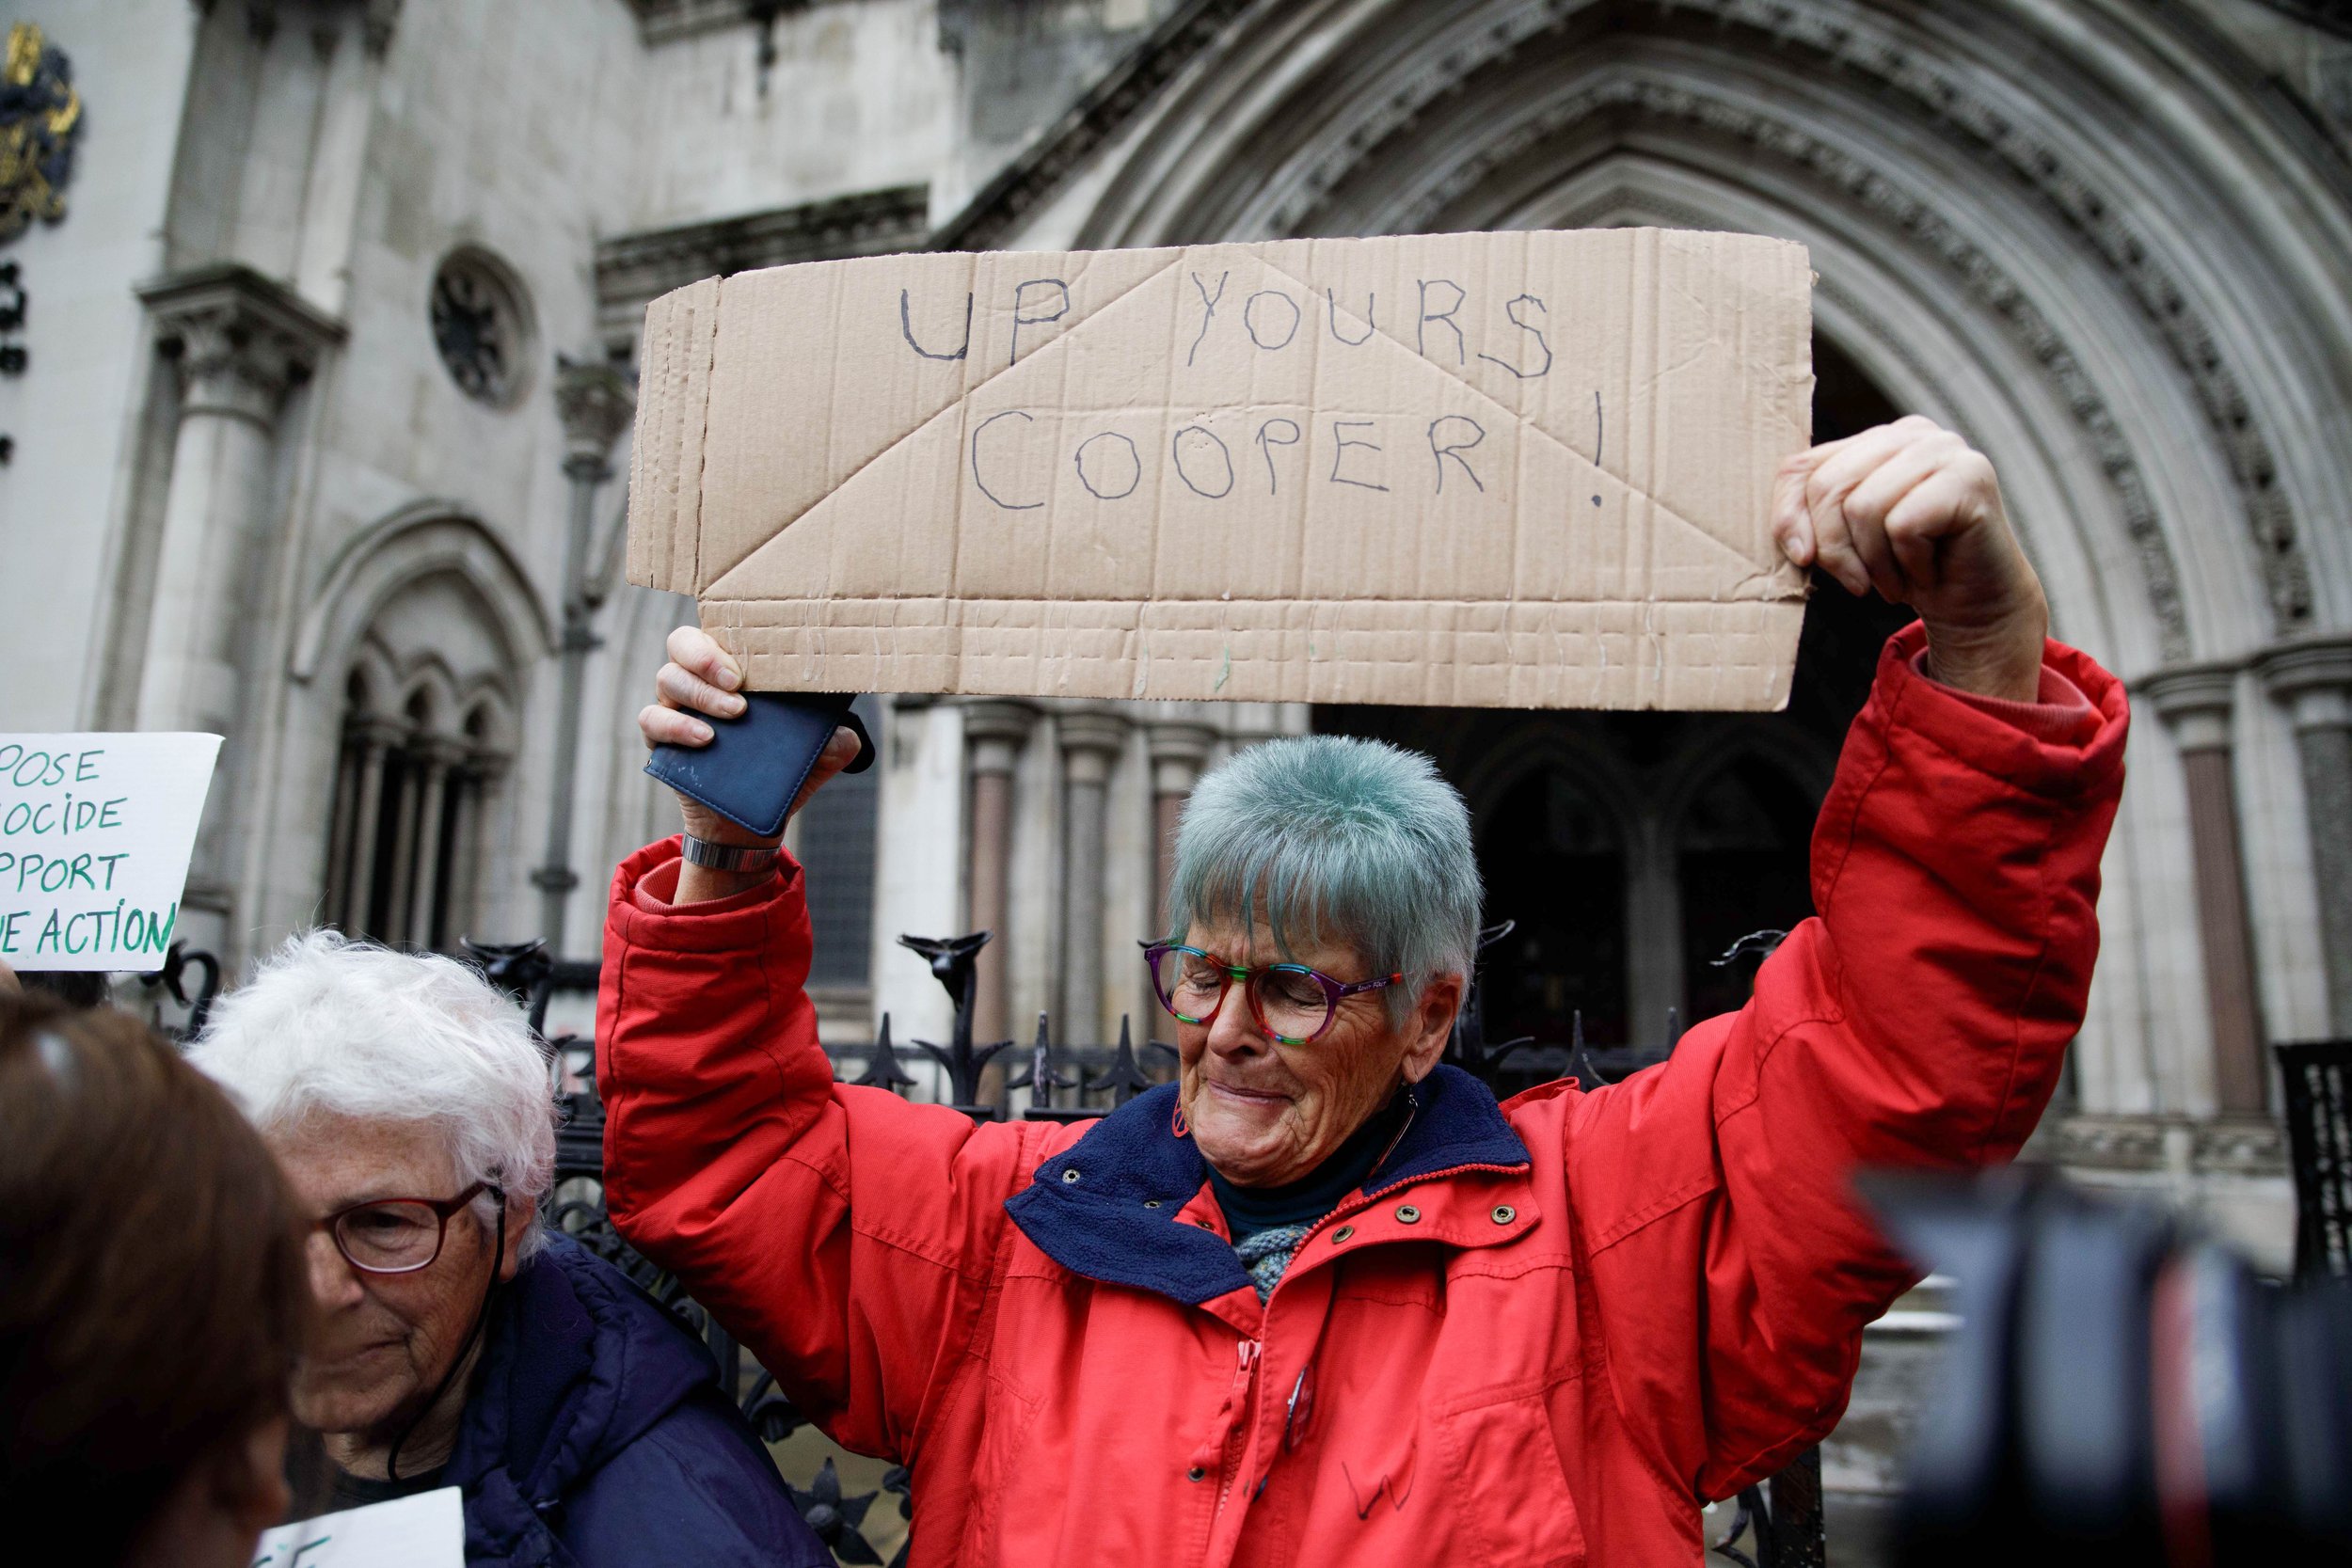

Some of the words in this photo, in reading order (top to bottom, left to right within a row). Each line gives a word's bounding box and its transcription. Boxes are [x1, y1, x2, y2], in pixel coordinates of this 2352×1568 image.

[900, 278, 1071, 367] UP
[1188, 270, 1553, 379] YOURS
[36, 897, 178, 955] ACTION
